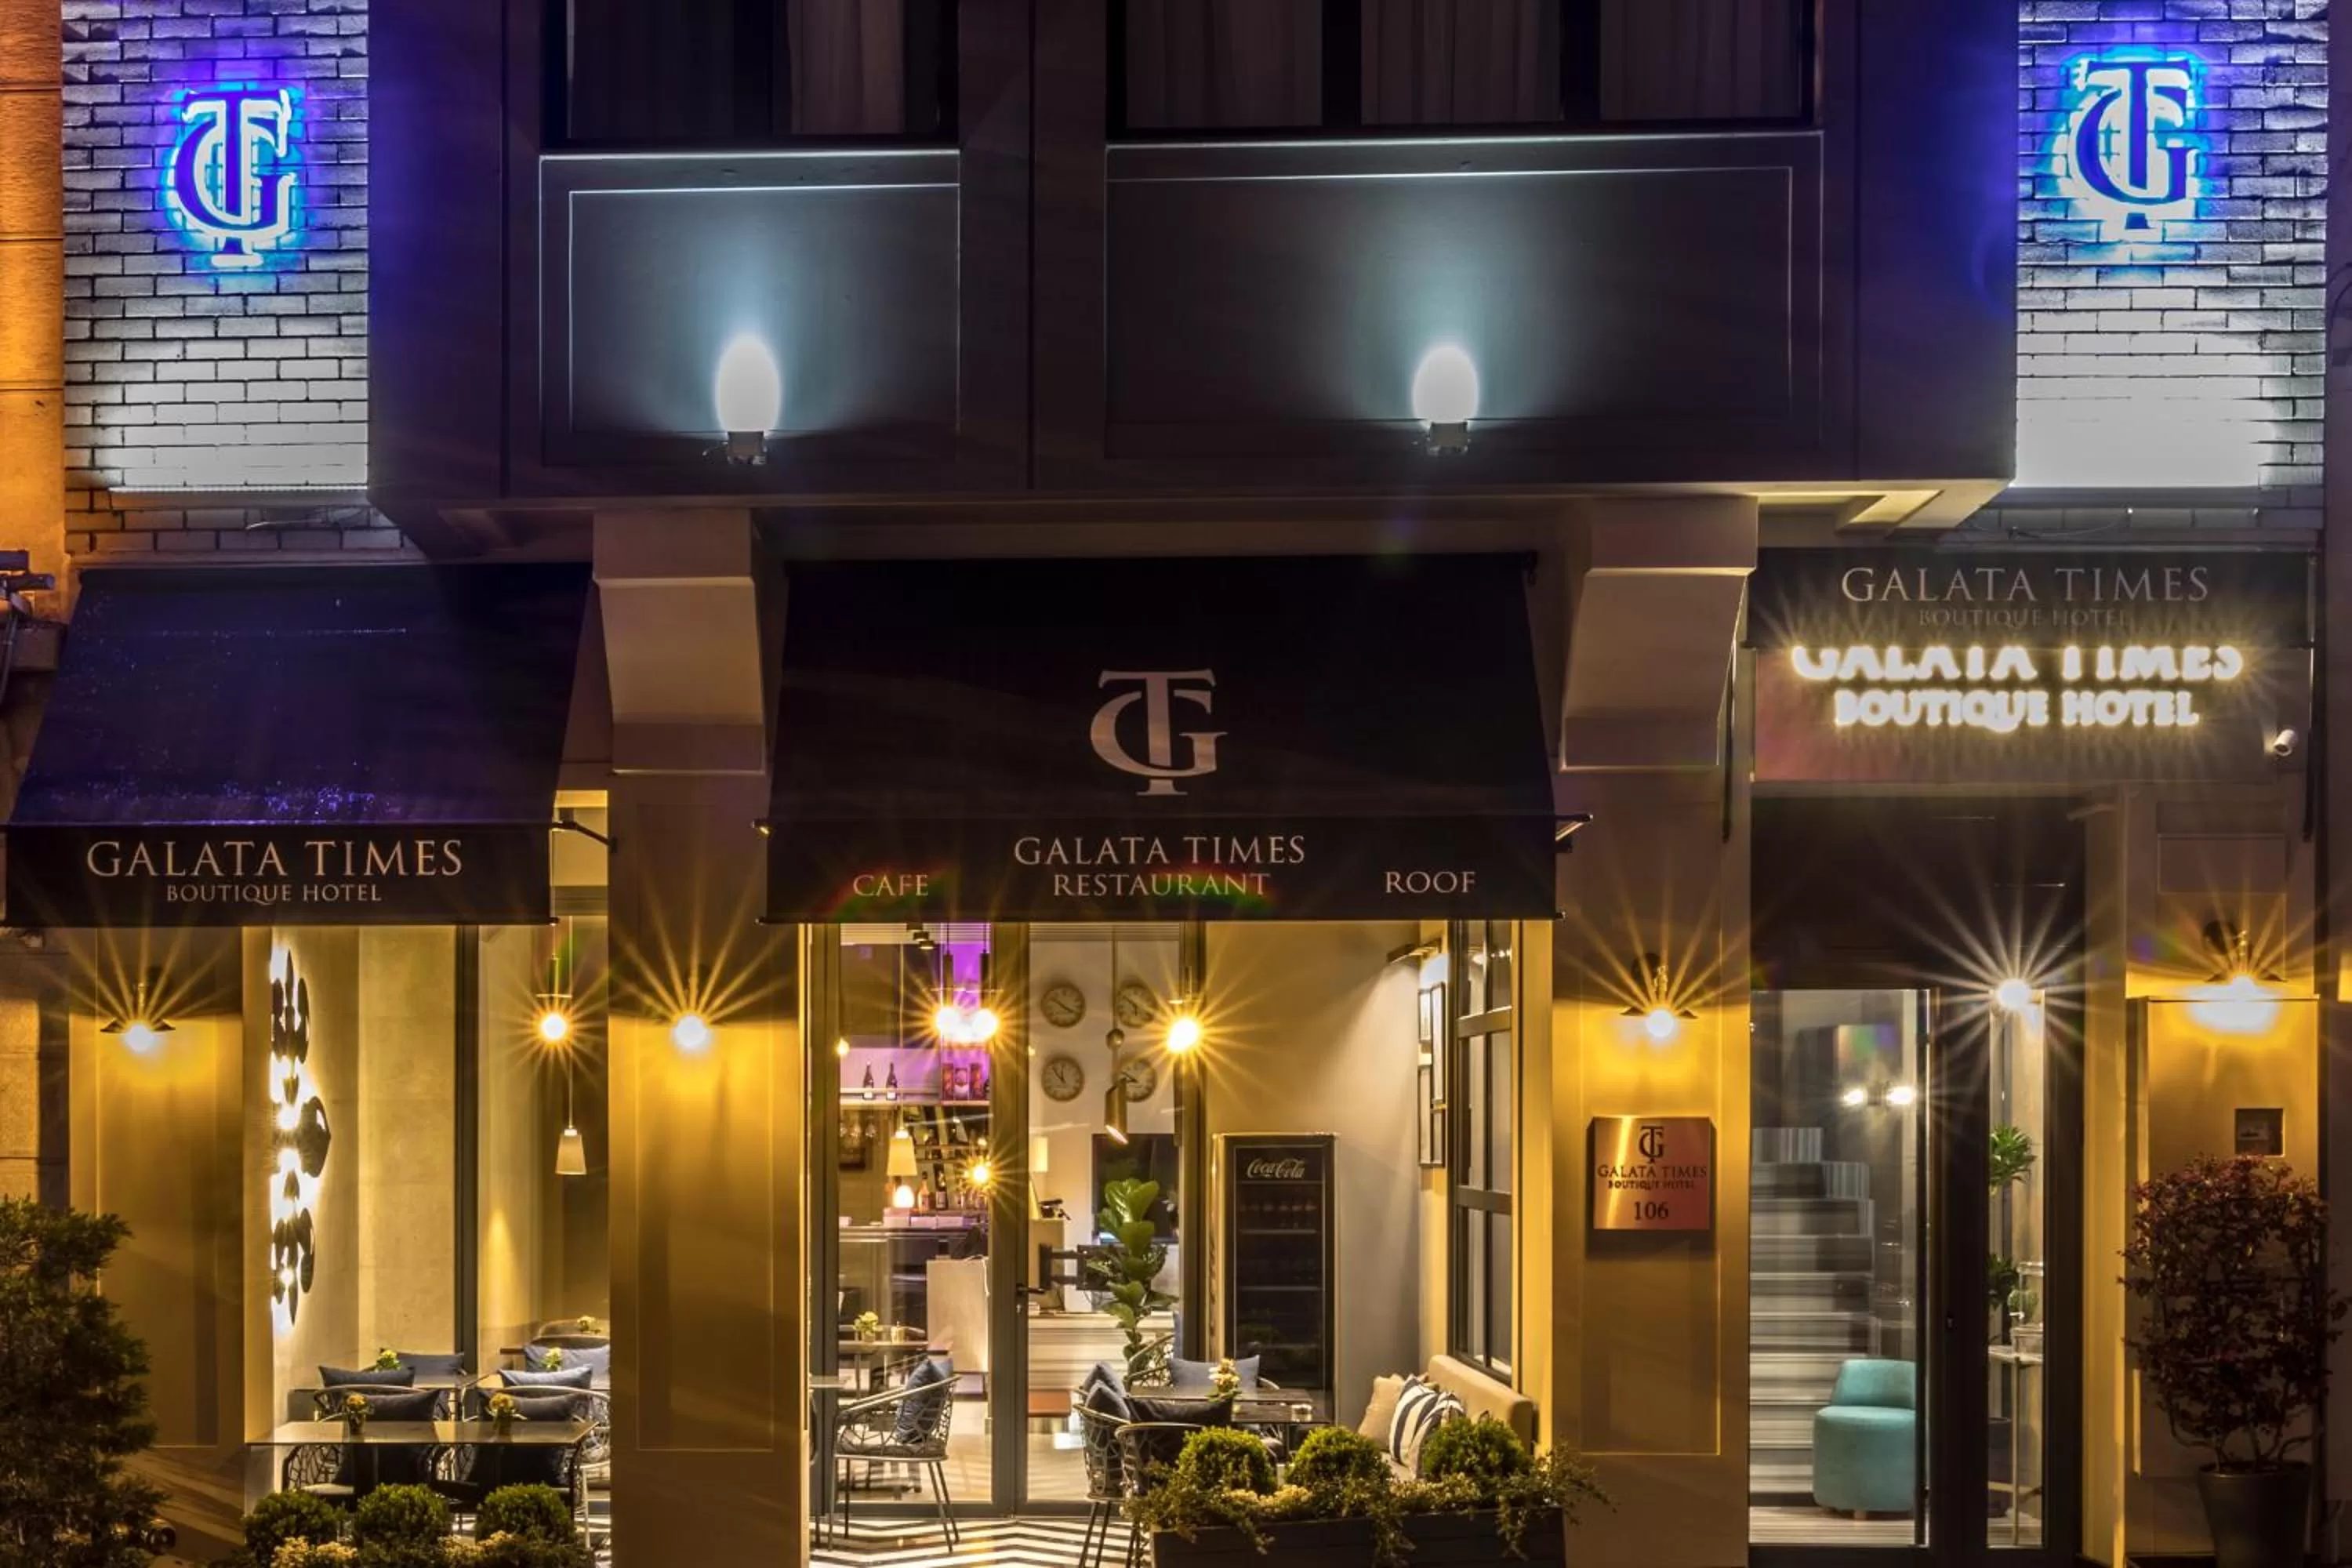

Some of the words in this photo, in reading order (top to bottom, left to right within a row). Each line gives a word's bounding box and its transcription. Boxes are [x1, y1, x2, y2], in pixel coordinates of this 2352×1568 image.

[1841, 568, 2037, 602] GALATA
[2055, 568, 2209, 602] TIMES
[1918, 608, 2042, 628] BOUTIQUE
[2052, 608, 2130, 627] HOTEL
[1833, 689, 2049, 732] BOUTIQUE
[2060, 689, 2200, 728] HOTEL
[86, 840, 289, 877] GALATA
[304, 839, 463, 877] TIMES
[1014, 836, 1170, 866] GALATA
[1184, 835, 1306, 866] TIMES
[852, 874, 930, 897] CAFE
[1054, 873, 1270, 896] RESTAURANT
[1385, 871, 1477, 894] ROOF
[166, 884, 292, 905] BOUTIQUE
[303, 884, 382, 902] HOTEL
[1597, 1165, 1656, 1178] GALATA
[1662, 1167, 1707, 1178] TIMES
[1633, 1202, 1669, 1220] 106
